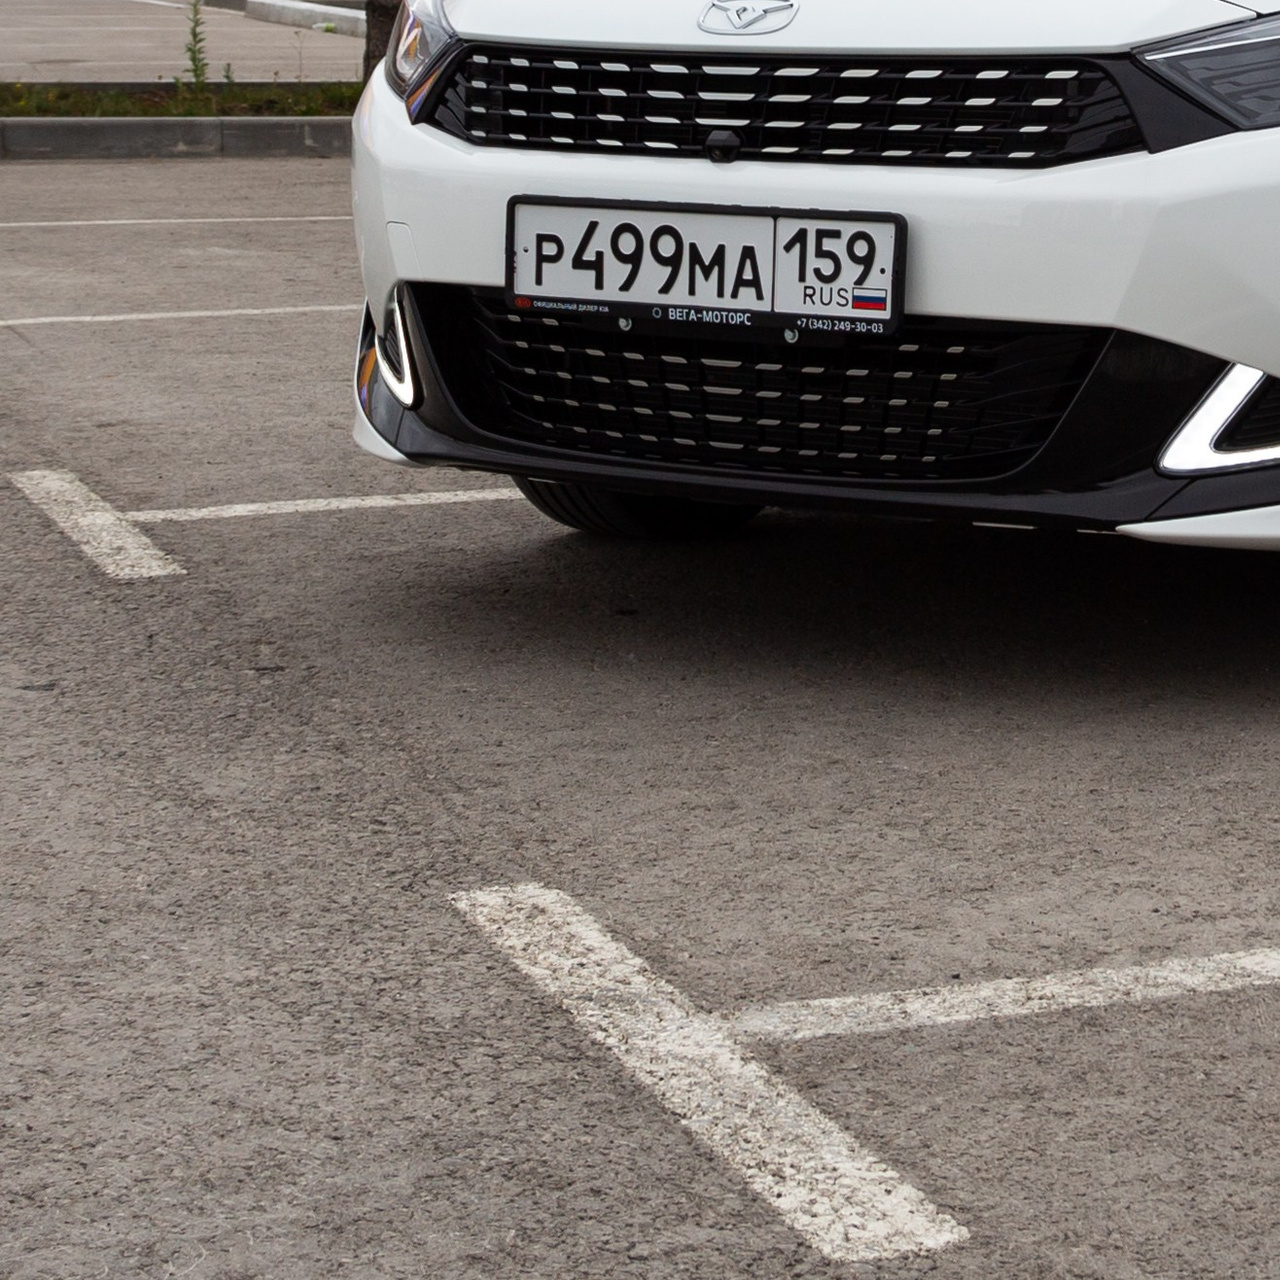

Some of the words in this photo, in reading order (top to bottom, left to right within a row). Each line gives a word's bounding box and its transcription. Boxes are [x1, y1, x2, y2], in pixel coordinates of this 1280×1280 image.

[534, 220, 765, 301] Р499МА
[782, 227, 877, 286] 159
[802, 286, 850, 307] RUS
[668, 308, 752, 326] ВЕГА-МОТОРС
[808, 319, 832, 331] (342)
[834, 320, 884, 333] 249-30-03
